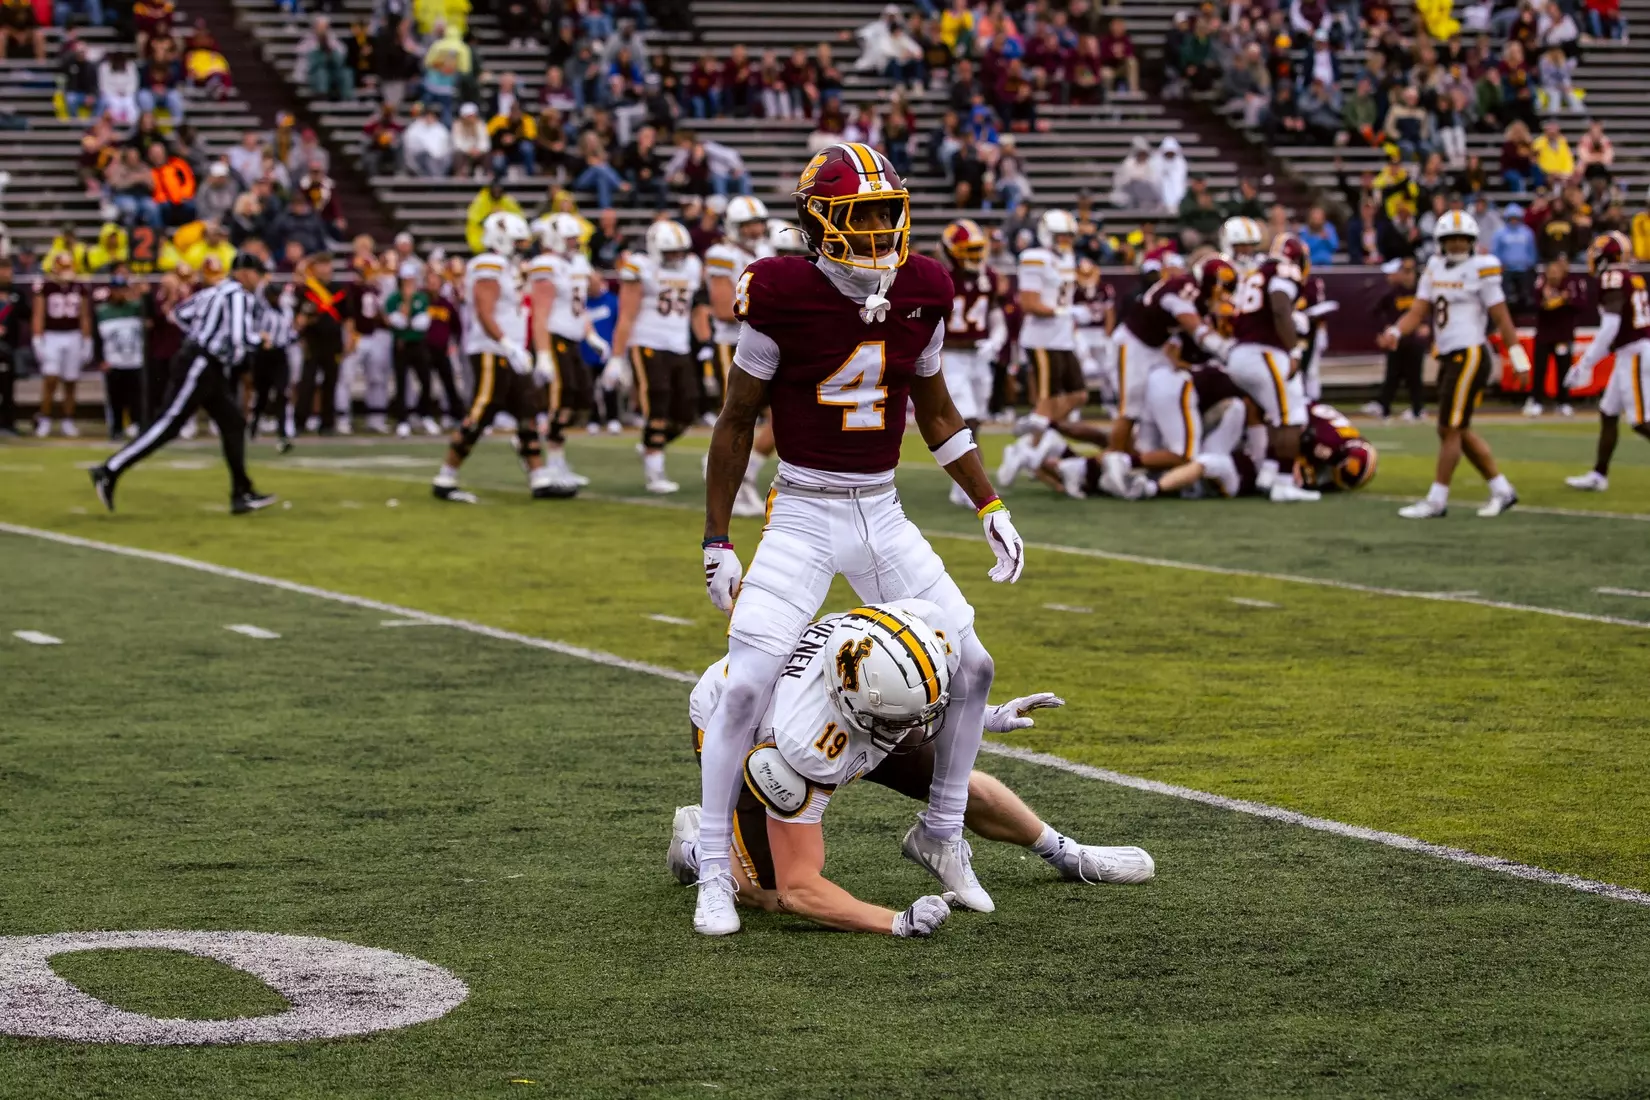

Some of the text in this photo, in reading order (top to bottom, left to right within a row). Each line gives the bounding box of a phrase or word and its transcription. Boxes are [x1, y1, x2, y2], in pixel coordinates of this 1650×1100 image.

[134, 227, 154, 259] 2
[948, 294, 989, 332] 14
[816, 340, 888, 431] 4
[780, 617, 842, 679] UENEN
[814, 721, 849, 761] 19
